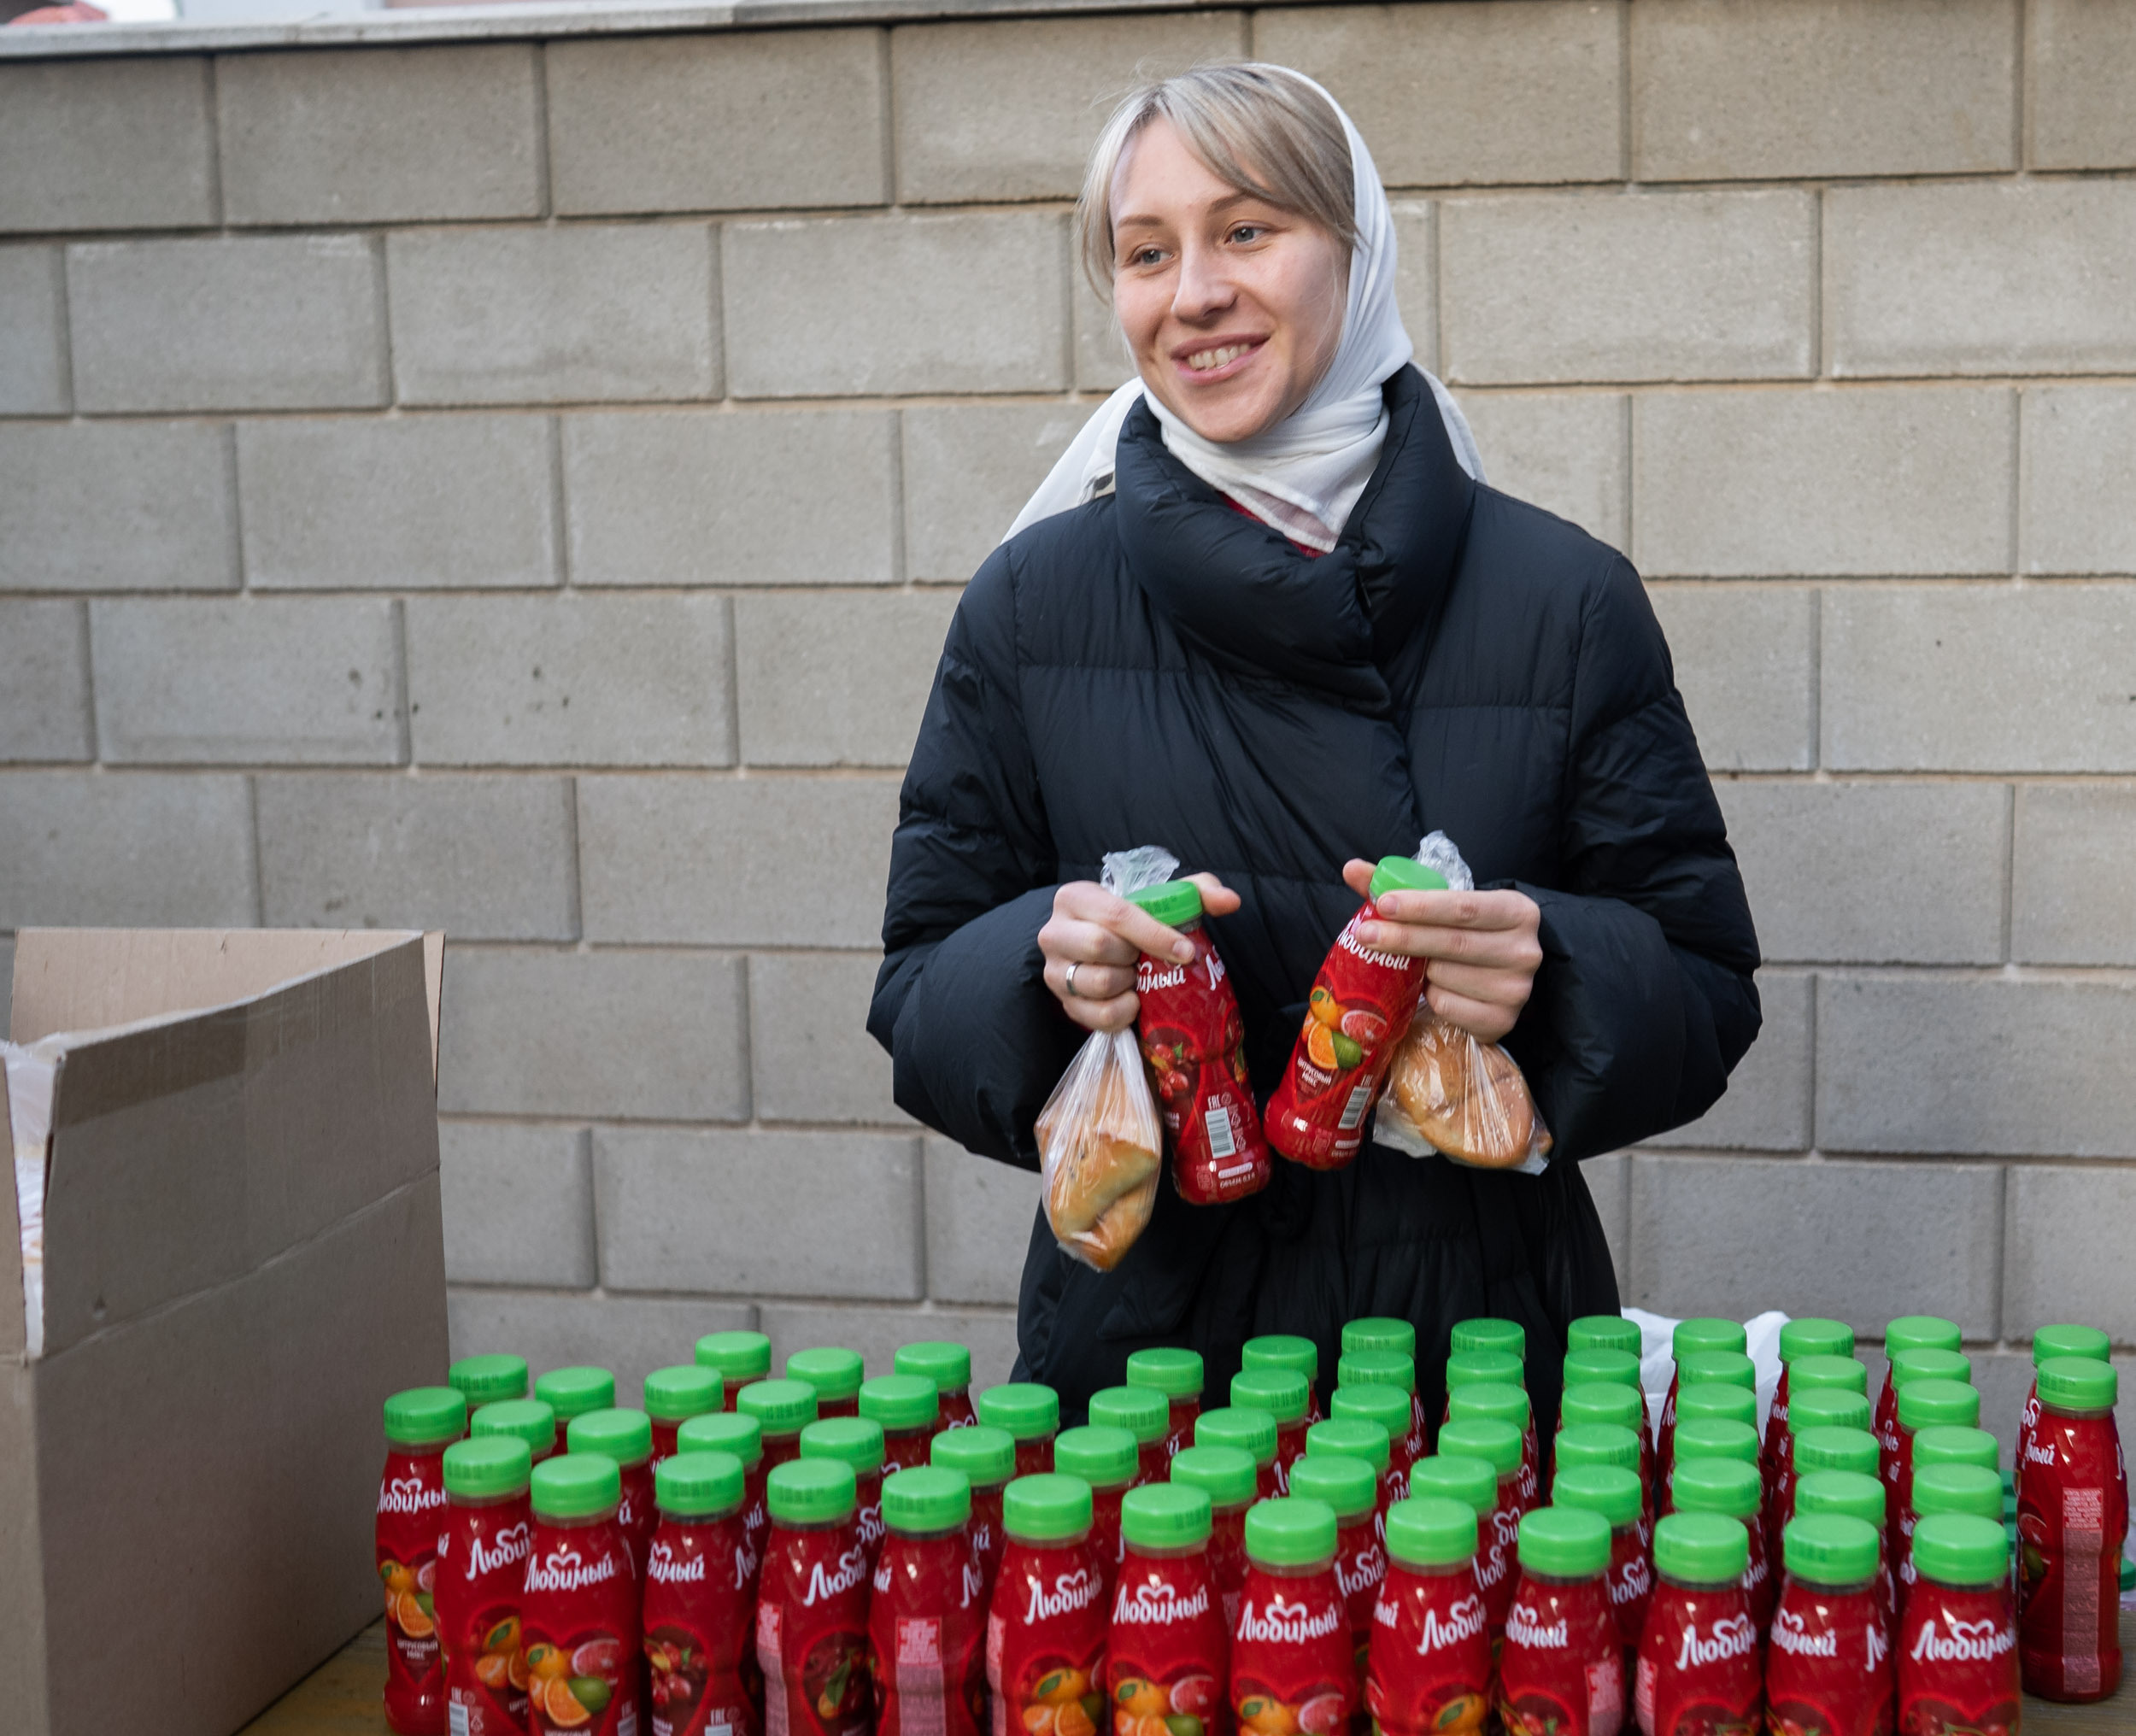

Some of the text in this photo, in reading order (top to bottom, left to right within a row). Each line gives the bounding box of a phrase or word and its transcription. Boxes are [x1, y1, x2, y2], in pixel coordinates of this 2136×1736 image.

[524, 1551, 614, 1594] Любимый
[1112, 1582, 1210, 1627] Любимый
[1237, 1599, 1340, 1645] Любимый
